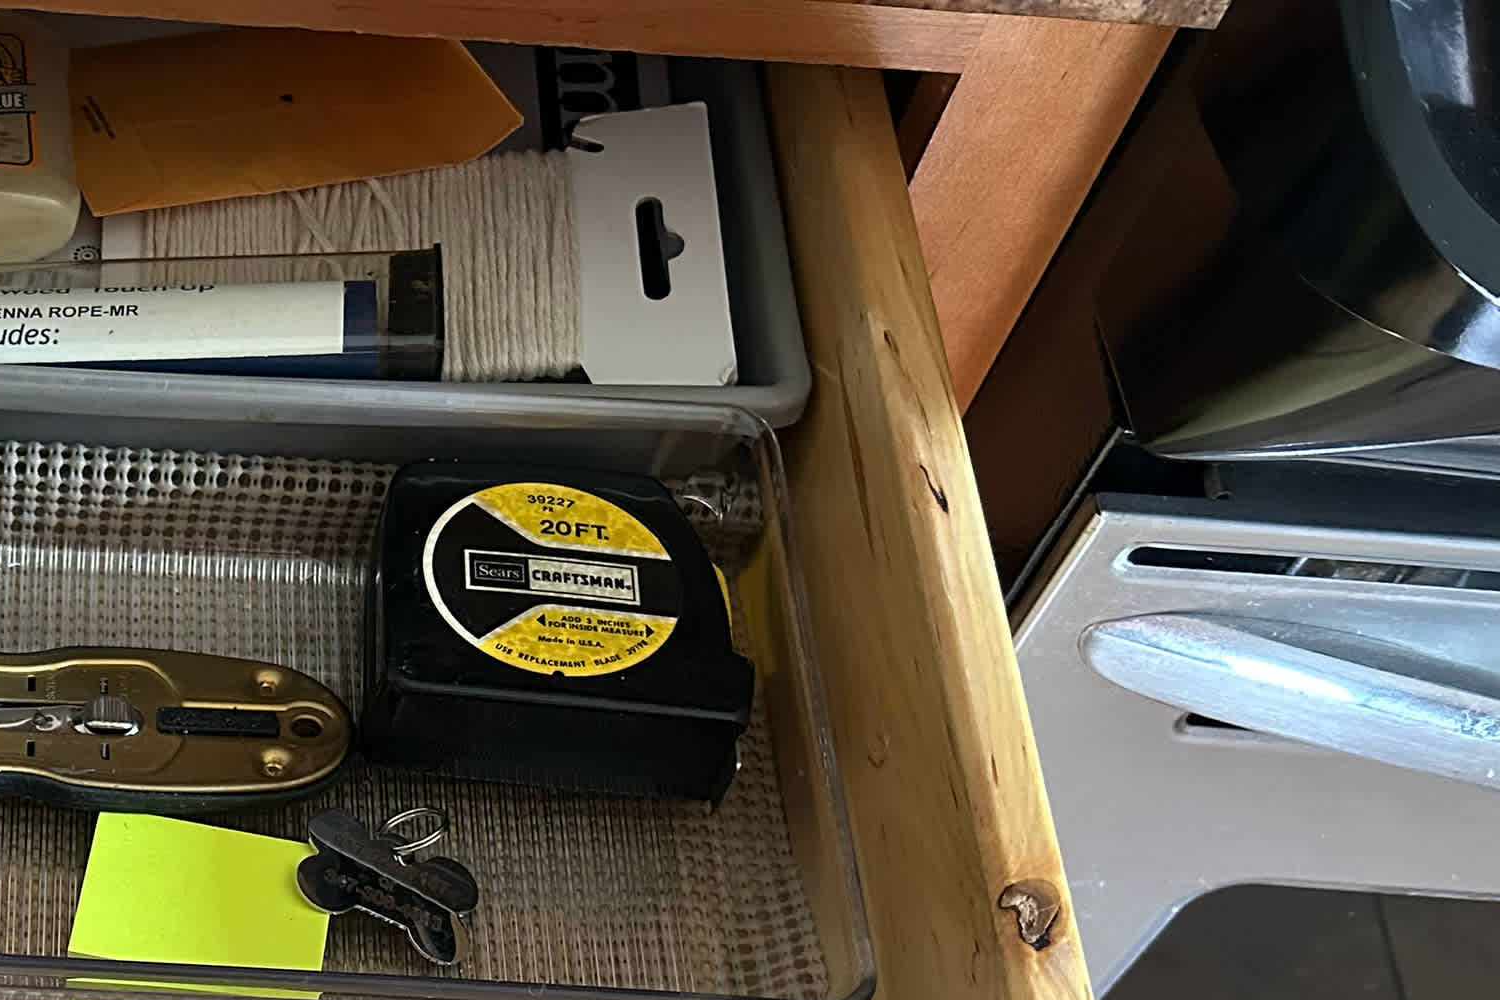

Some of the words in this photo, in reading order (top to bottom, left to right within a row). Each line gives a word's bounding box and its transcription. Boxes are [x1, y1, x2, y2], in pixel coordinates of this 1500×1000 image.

[47, 304, 140, 319] ROPE-MR
[526, 493, 576, 510] 39227
[477, 564, 521, 581] Sears
[548, 620, 566, 629] FOR
[569, 623, 598, 633] INSIDE
[601, 627, 645, 638] MEASURE
[561, 615, 581, 624] ADD
[596, 619, 631, 629] INCHES
[537, 635, 563, 645] Made
[566, 638, 575, 646] in
[578, 639, 605, 649] U.S.A.
[494, 643, 512, 655] USE
[518, 652, 586, 668] REPLACEMENT
[594, 654, 621, 666] BLADE
